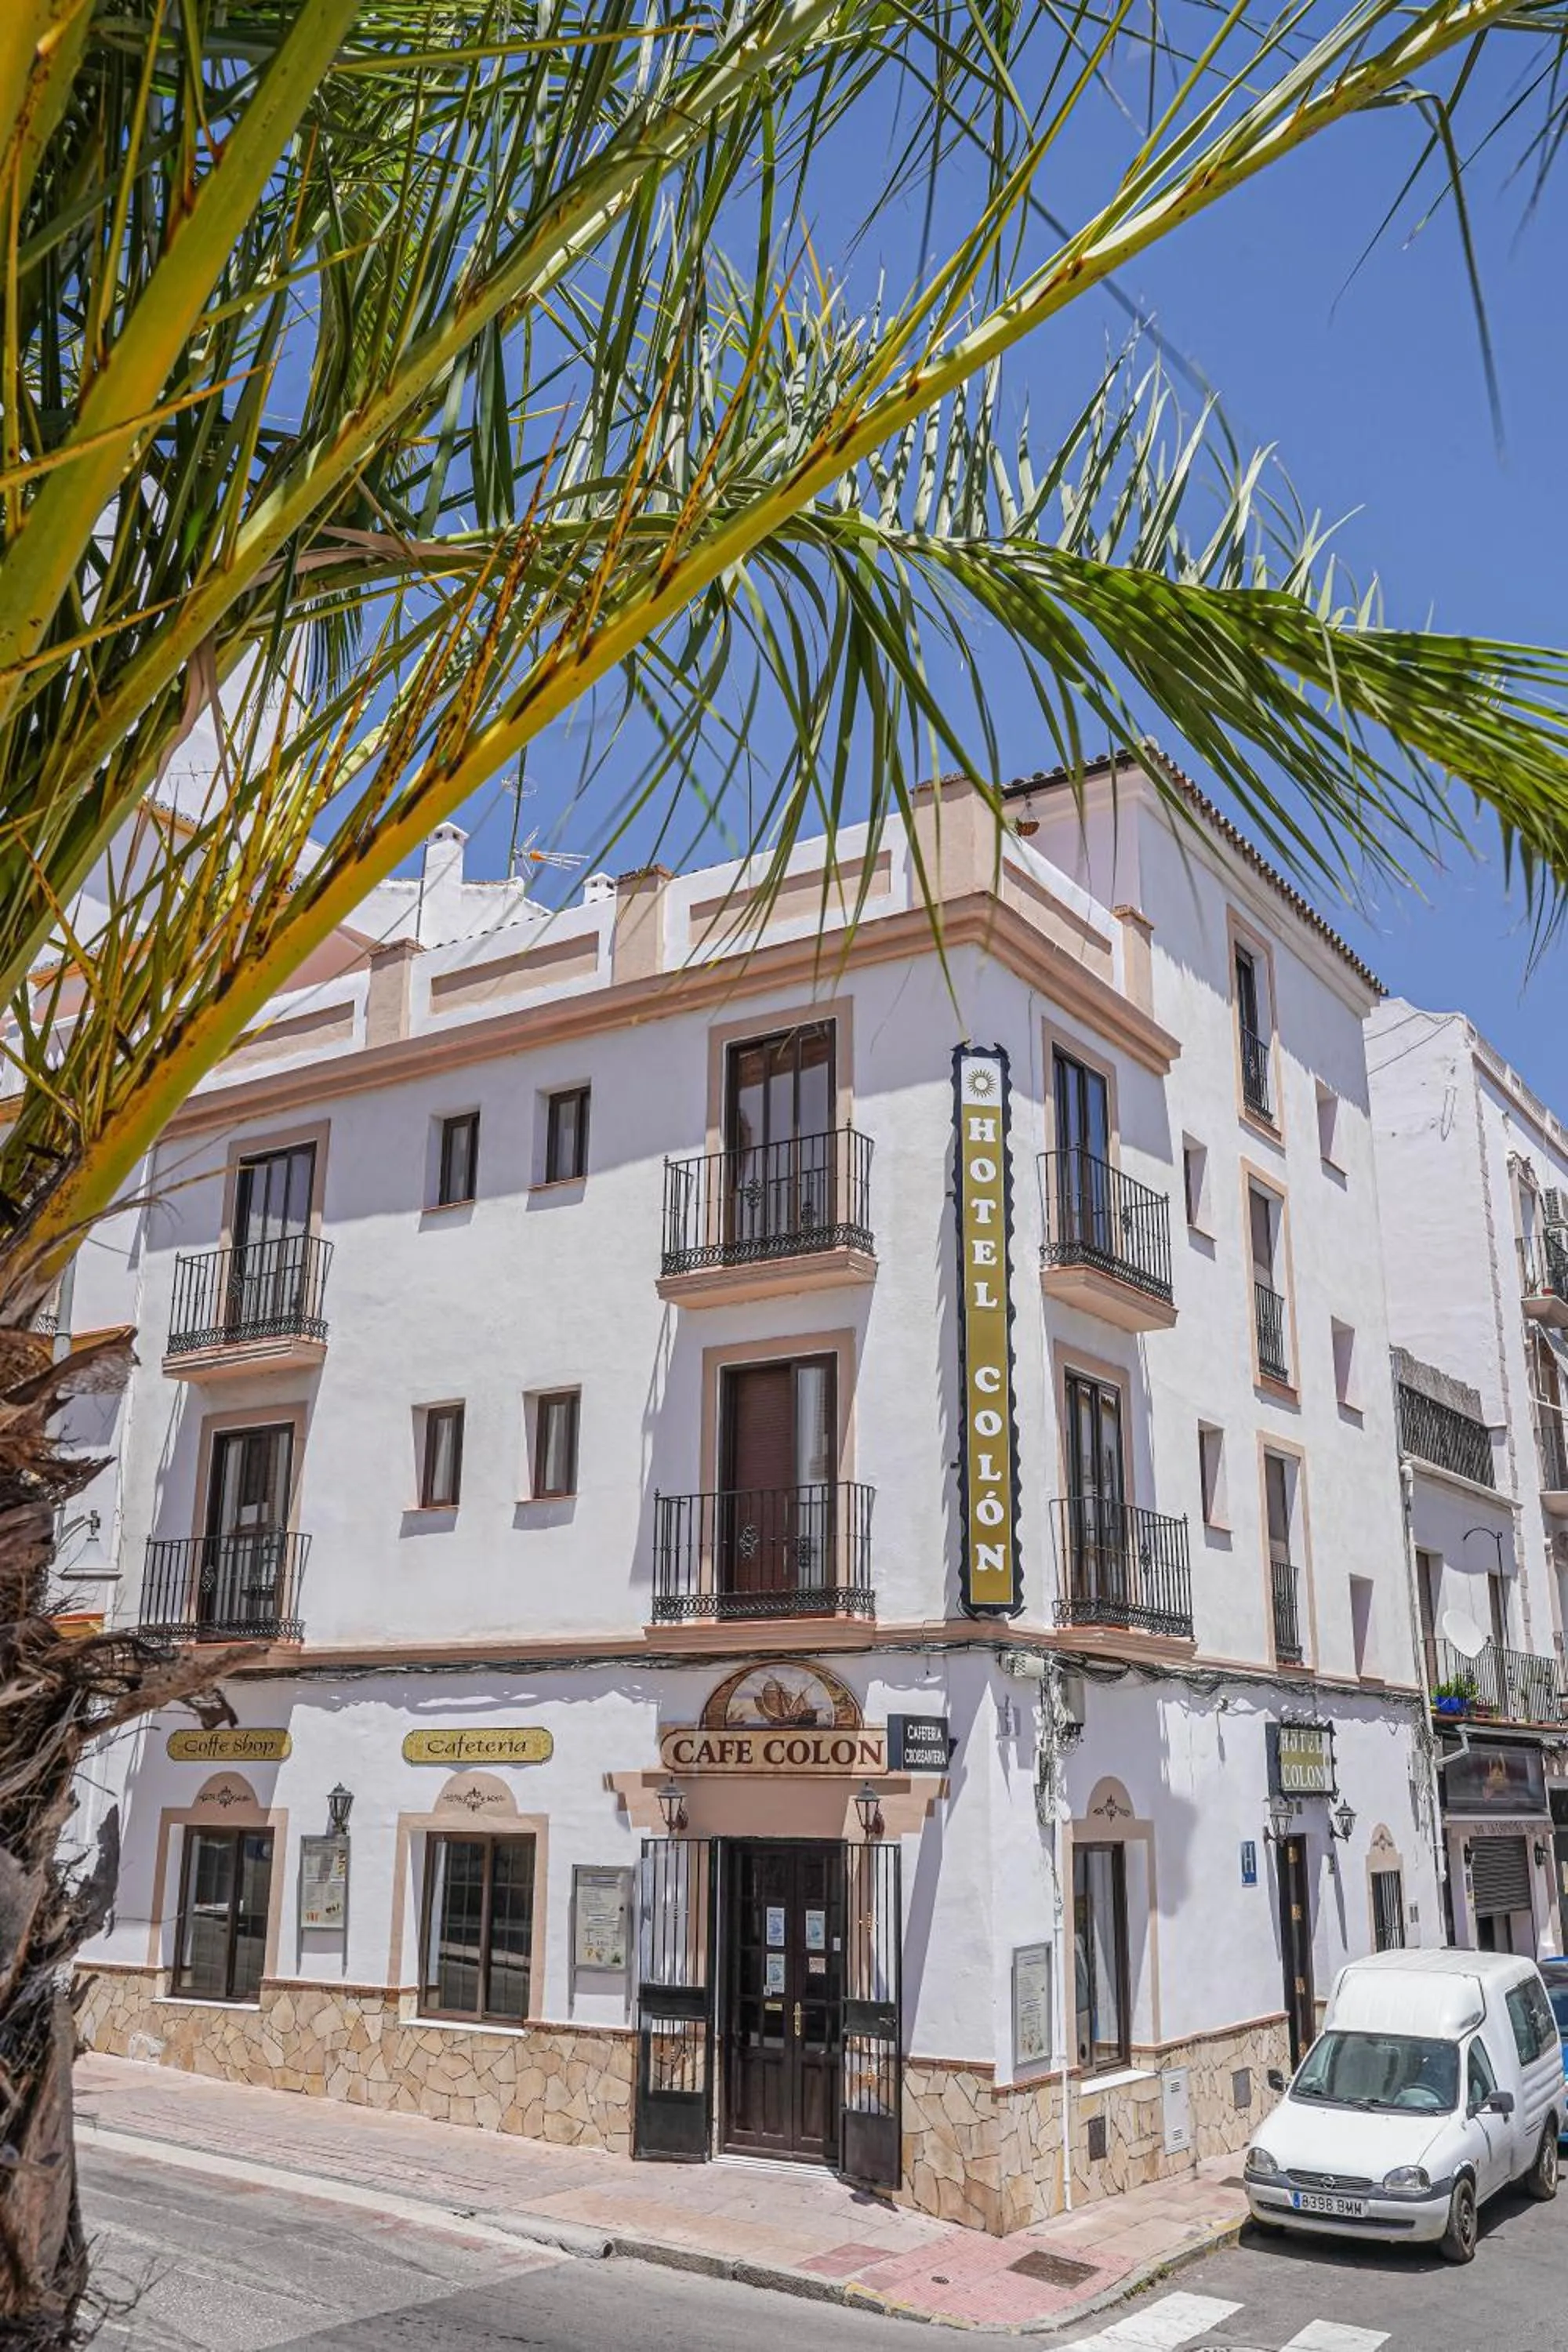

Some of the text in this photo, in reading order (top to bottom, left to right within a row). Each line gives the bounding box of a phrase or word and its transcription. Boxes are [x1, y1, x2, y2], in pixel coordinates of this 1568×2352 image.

[967, 1116, 1006, 1572] HOTEL COLÓN
[183, 1733, 276, 1757] Coffe Shop
[427, 1733, 528, 1759] Cafeteria
[672, 1738, 884, 1766] CAFE COLON
[1281, 1729, 1323, 1754] HOTEL
